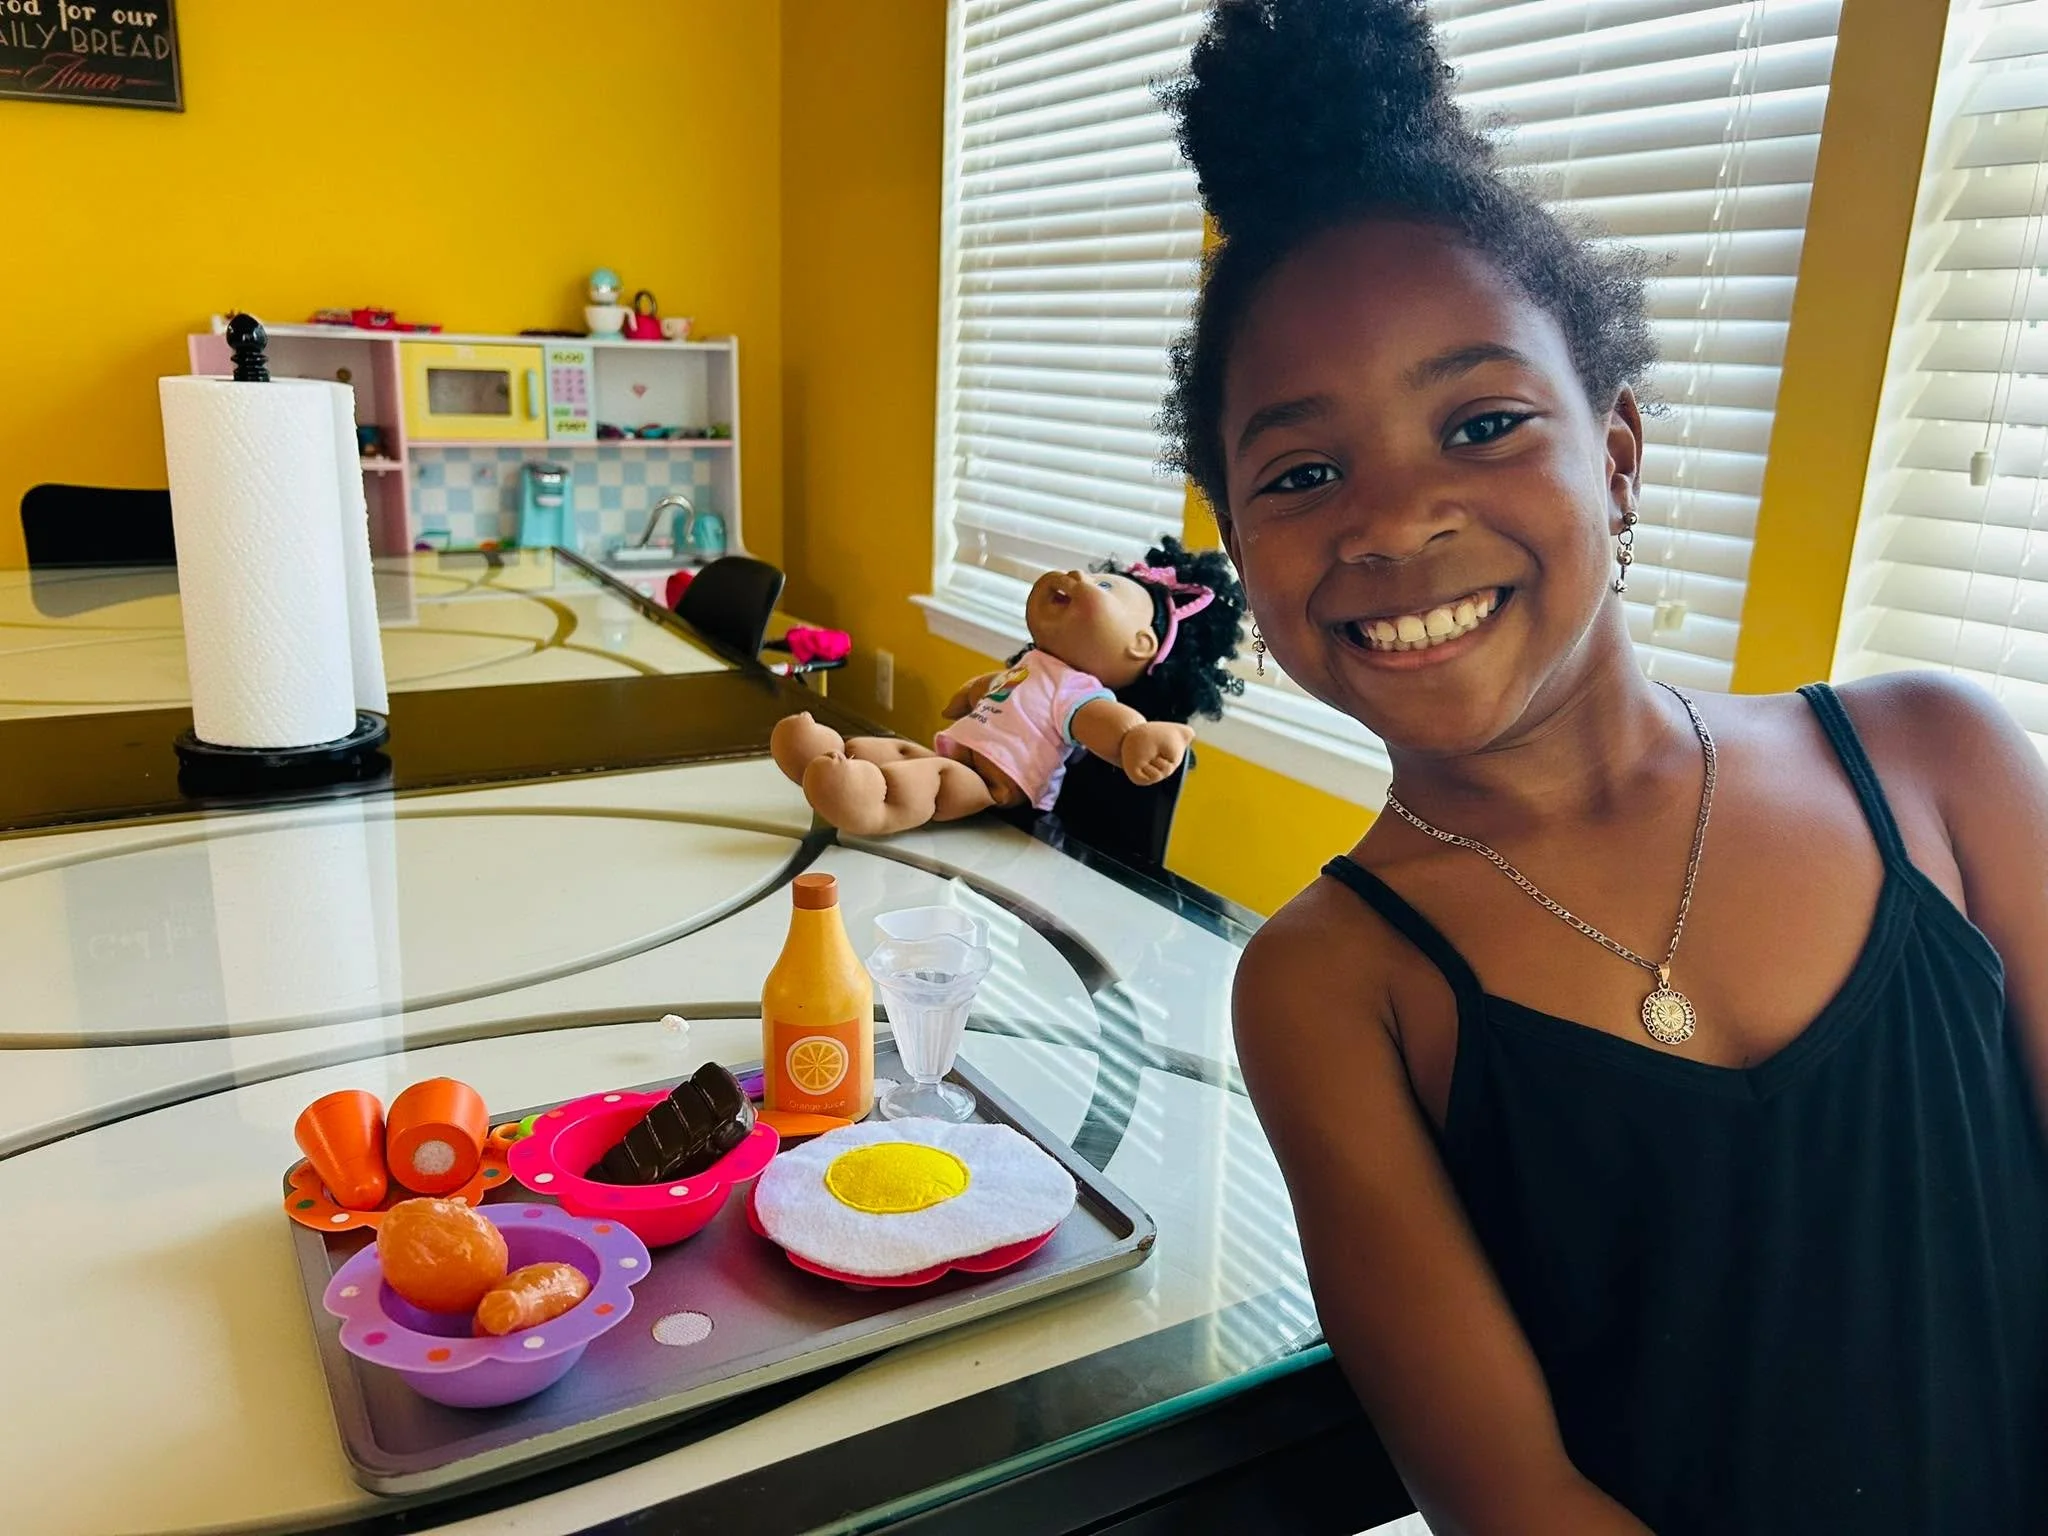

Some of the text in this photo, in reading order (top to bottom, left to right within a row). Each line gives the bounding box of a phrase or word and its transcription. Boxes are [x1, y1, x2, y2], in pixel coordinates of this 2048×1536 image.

[57, 0, 97, 31] for
[112, 9, 158, 27] our
[71, 26, 170, 60] BREAD
